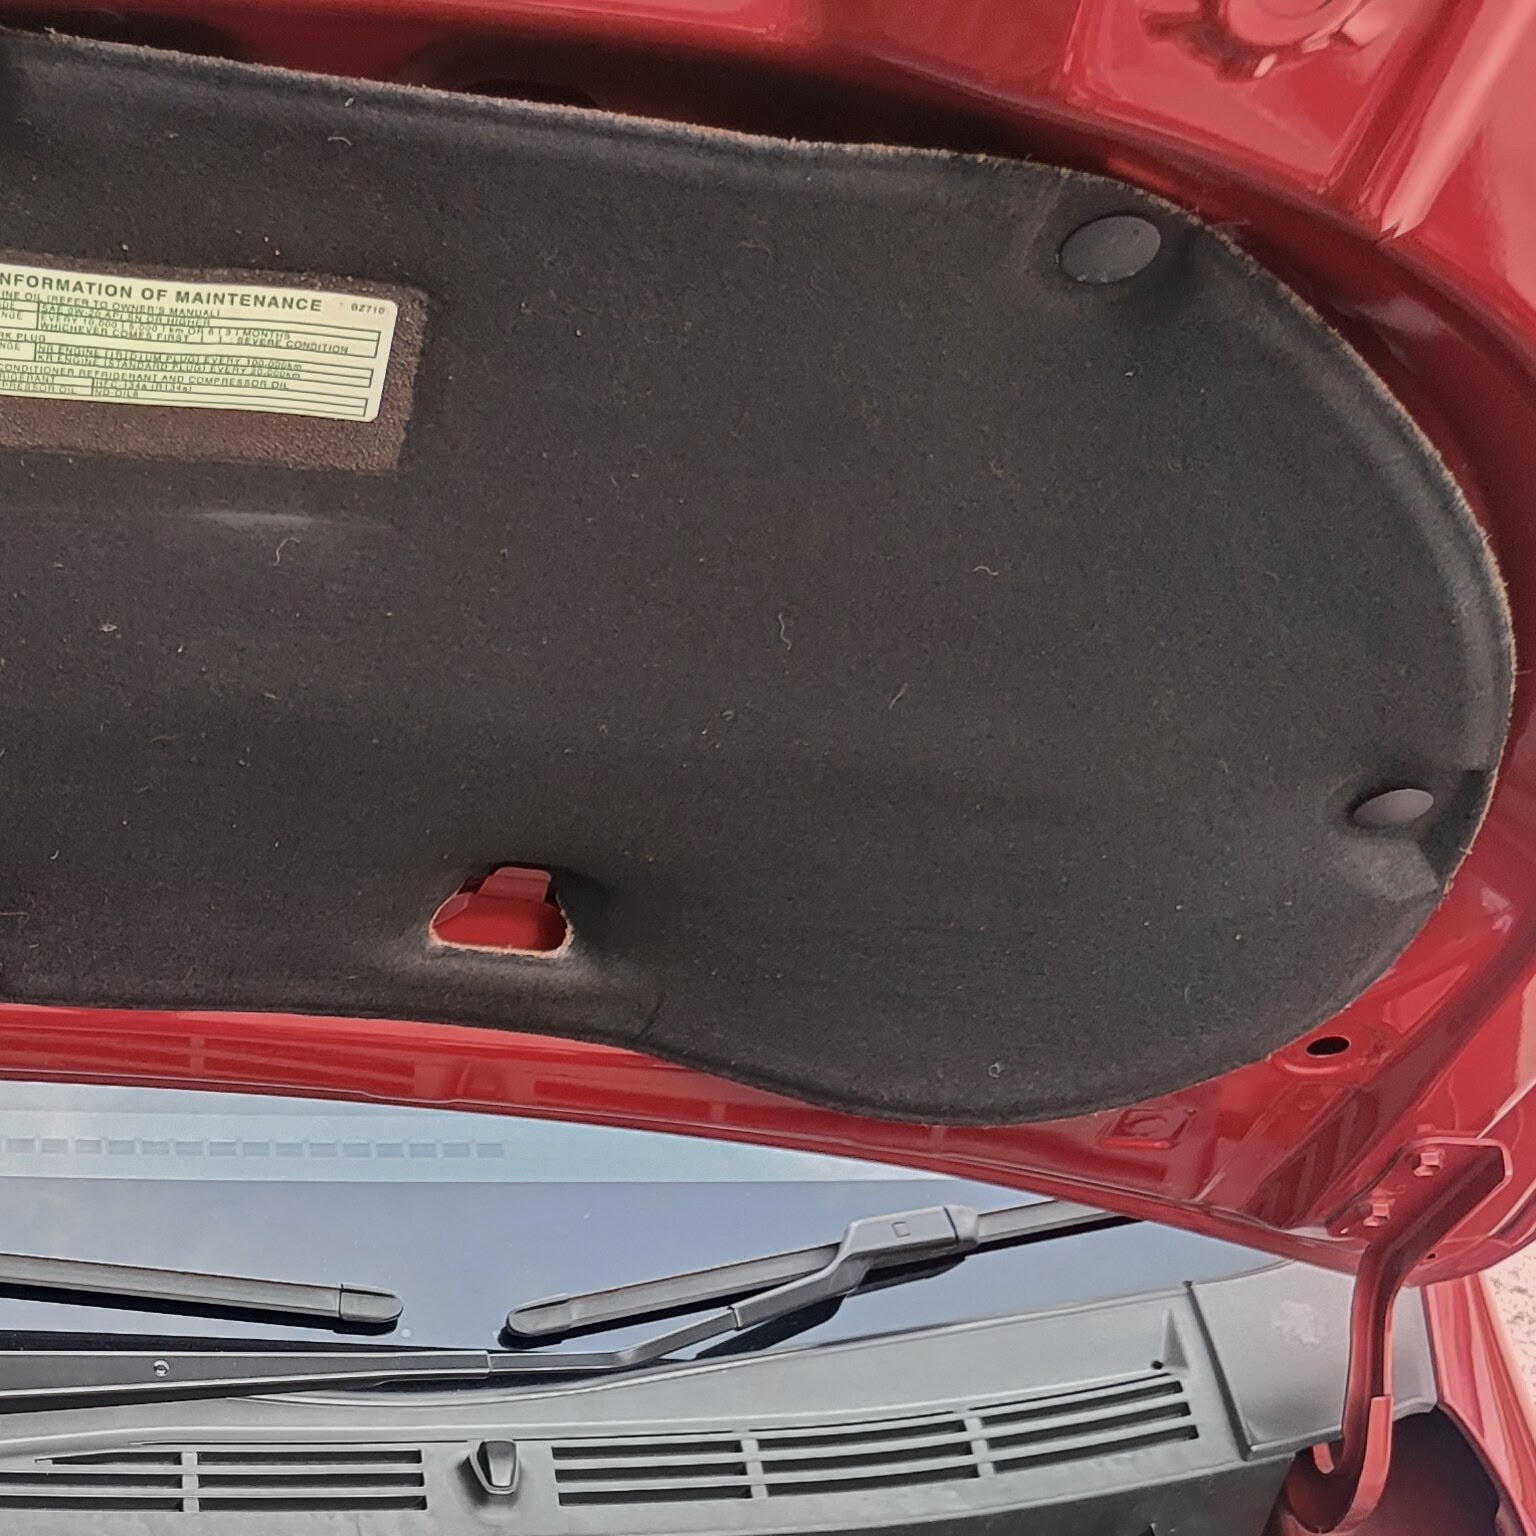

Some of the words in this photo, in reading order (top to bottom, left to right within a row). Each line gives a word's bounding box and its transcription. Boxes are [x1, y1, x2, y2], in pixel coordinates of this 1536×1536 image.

[25, 292, 40, 302] OIL
[93, 299, 107, 309] TO
[111, 301, 165, 315] OWNER'S
[140, 287, 167, 301] OF
[175, 290, 322, 311] MAINTENANCE
[41, 314, 77, 325] EVERY
[16, 332, 46, 343] PLUG
[40, 321, 107, 335] WHICHEVER
[112, 329, 152, 340] COMES
[157, 332, 188, 342] FIRST
[237, 336, 281, 347] SEVERE
[285, 340, 348, 354] CONDITION
[58, 346, 98, 357] ENGINE
[204, 357, 239, 366] EVERY
[58, 355, 97, 366] ENGINE
[210, 365, 245, 375] EVERY
[78, 368, 157, 383] REFRIGERANT
[161, 374, 183, 383] AND
[188, 375, 267, 387] COMPRESSOR
[271, 380, 288, 389] OIL
